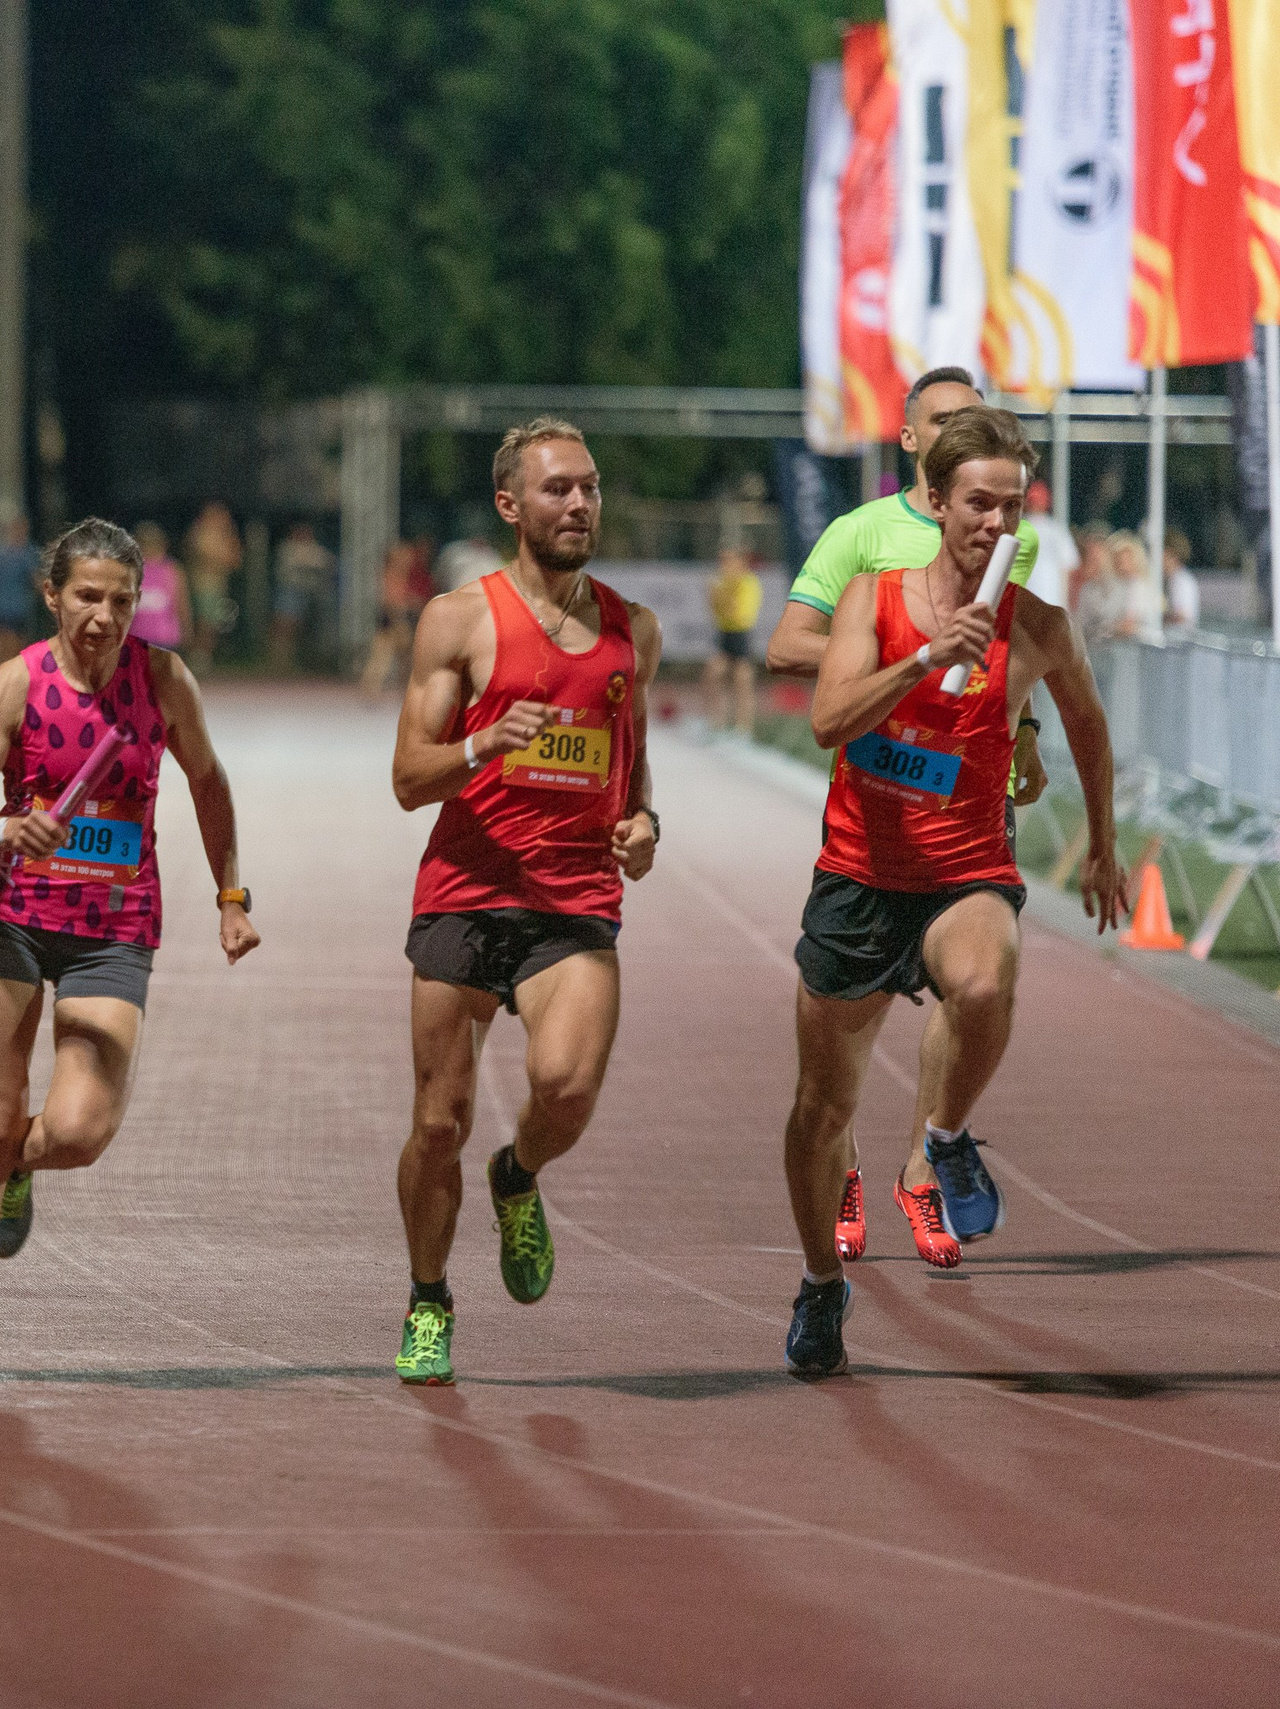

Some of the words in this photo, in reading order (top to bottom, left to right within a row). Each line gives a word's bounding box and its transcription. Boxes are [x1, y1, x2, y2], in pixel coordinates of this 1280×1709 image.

[539, 733, 586, 763] 308
[593, 750, 601, 765] 2
[874, 744, 926, 780] 308
[933, 772, 944, 786] 3
[61, 824, 112, 855] 309
[121, 842, 129, 857] 3
